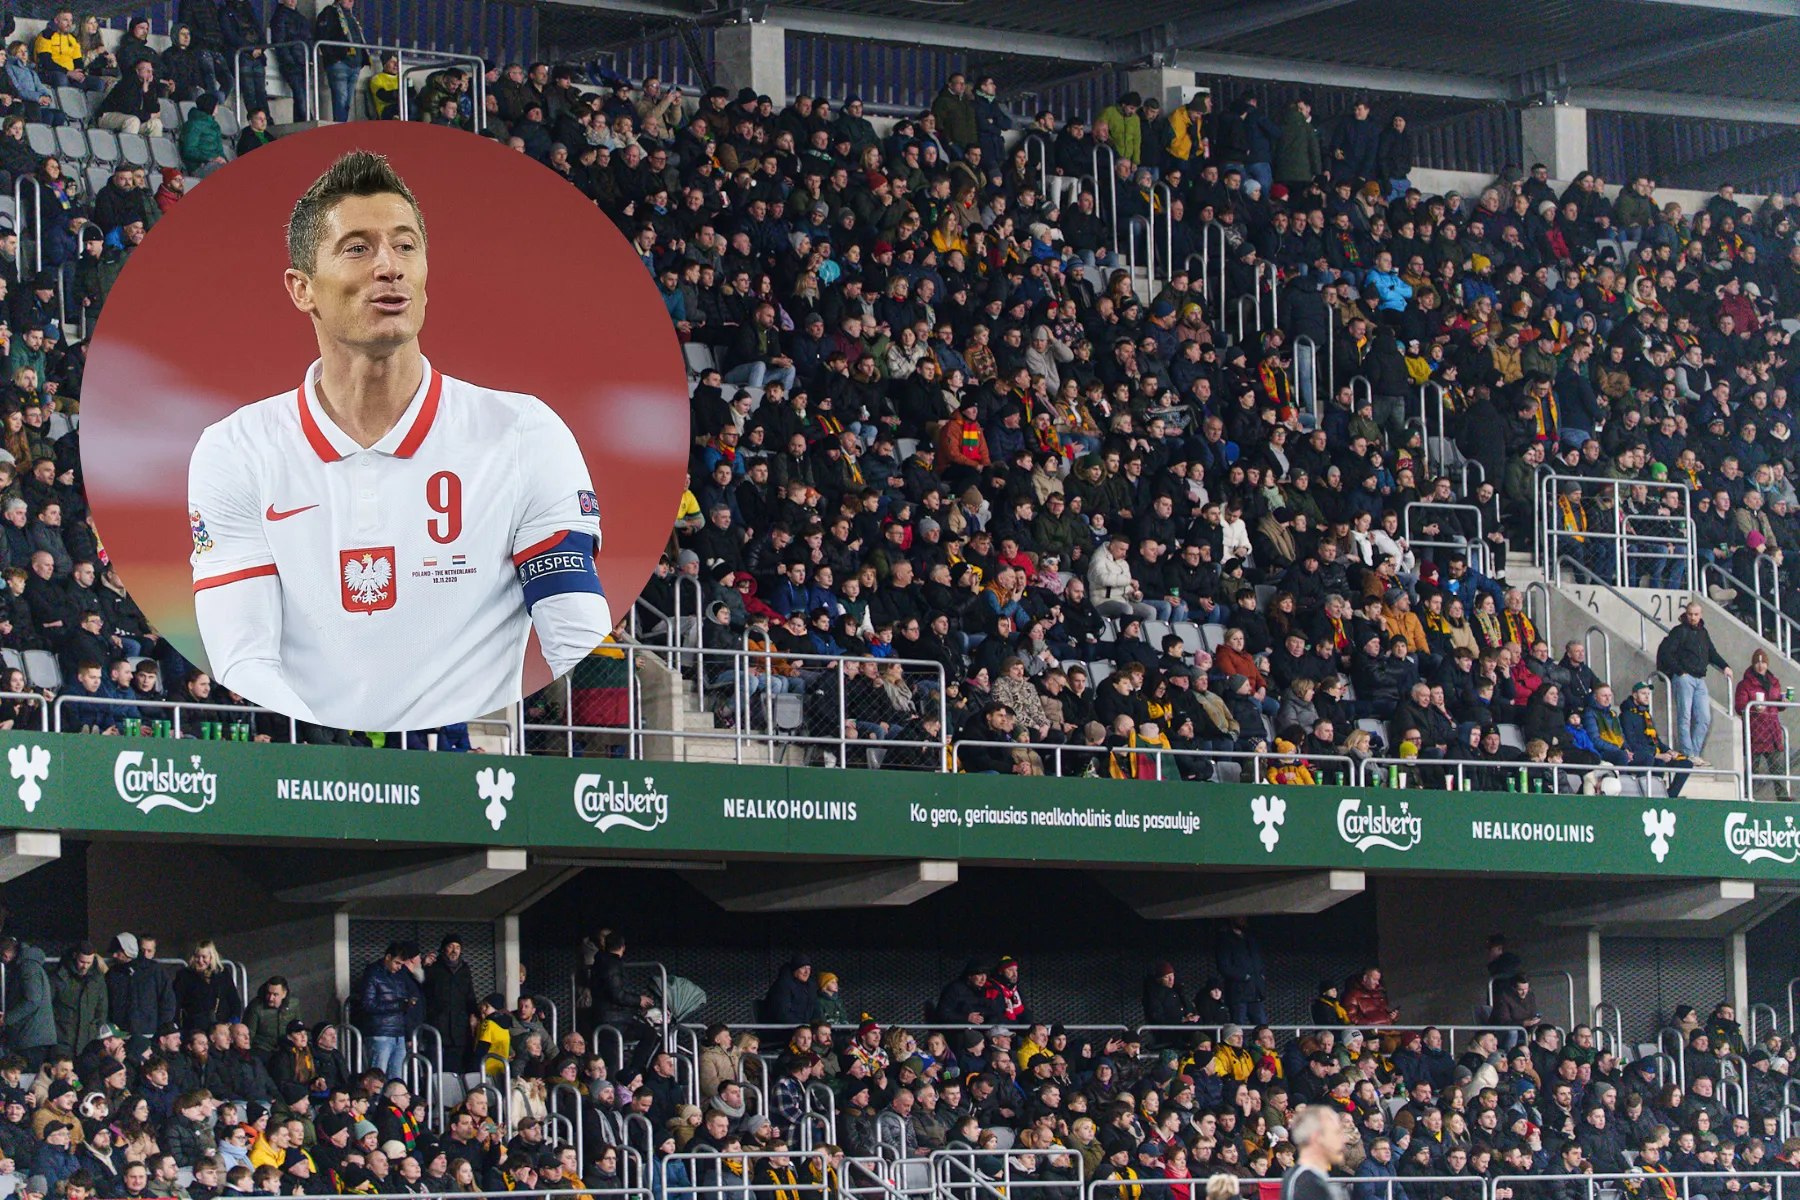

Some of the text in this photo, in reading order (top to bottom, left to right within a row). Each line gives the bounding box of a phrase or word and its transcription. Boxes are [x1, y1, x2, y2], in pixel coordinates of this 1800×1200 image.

[425, 470, 463, 544] 9
[444, 567, 477, 575] NETHERLANDS
[528, 556, 585, 576] RESPECT
[114, 751, 217, 814] Carlsberg
[277, 778, 420, 806] NEALKOHOLINIS
[574, 774, 668, 833] Carlsberg
[723, 798, 857, 821] NEALKOHOLINIS
[910, 803, 1201, 834] Ko gero, geriausias nealkoholinis alus pasaulyje
[1337, 799, 1422, 852] Carlsberg
[1472, 821, 1595, 843] NEALKOHOLINIS
